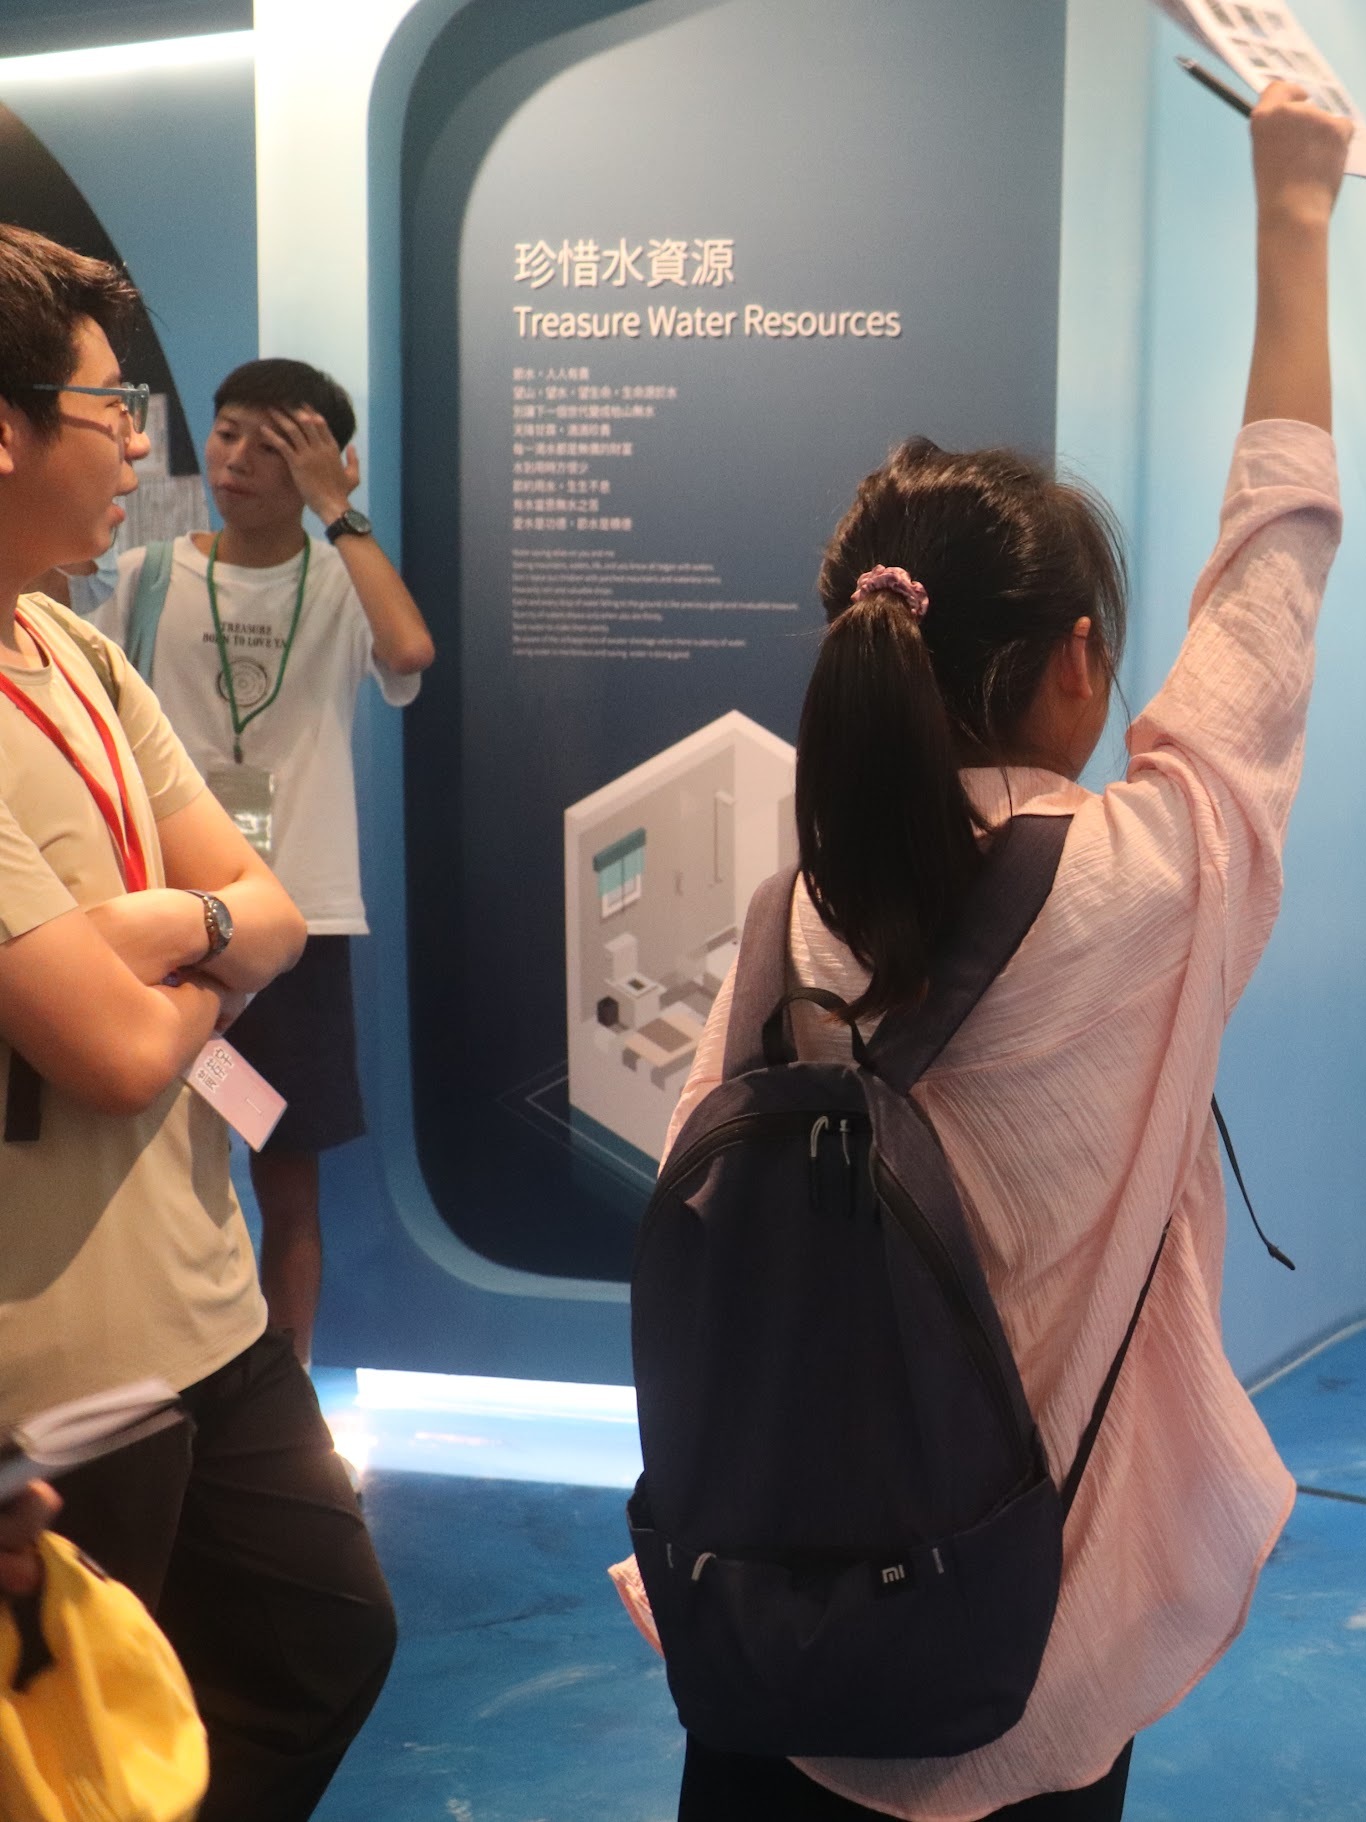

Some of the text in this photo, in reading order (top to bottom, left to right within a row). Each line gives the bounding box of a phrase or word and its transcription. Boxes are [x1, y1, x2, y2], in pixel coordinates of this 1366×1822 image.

[514, 237, 736, 288] 珍惜水資源
[513, 305, 902, 338] Treasure Water Resources
[234, 634, 245, 646] TO
